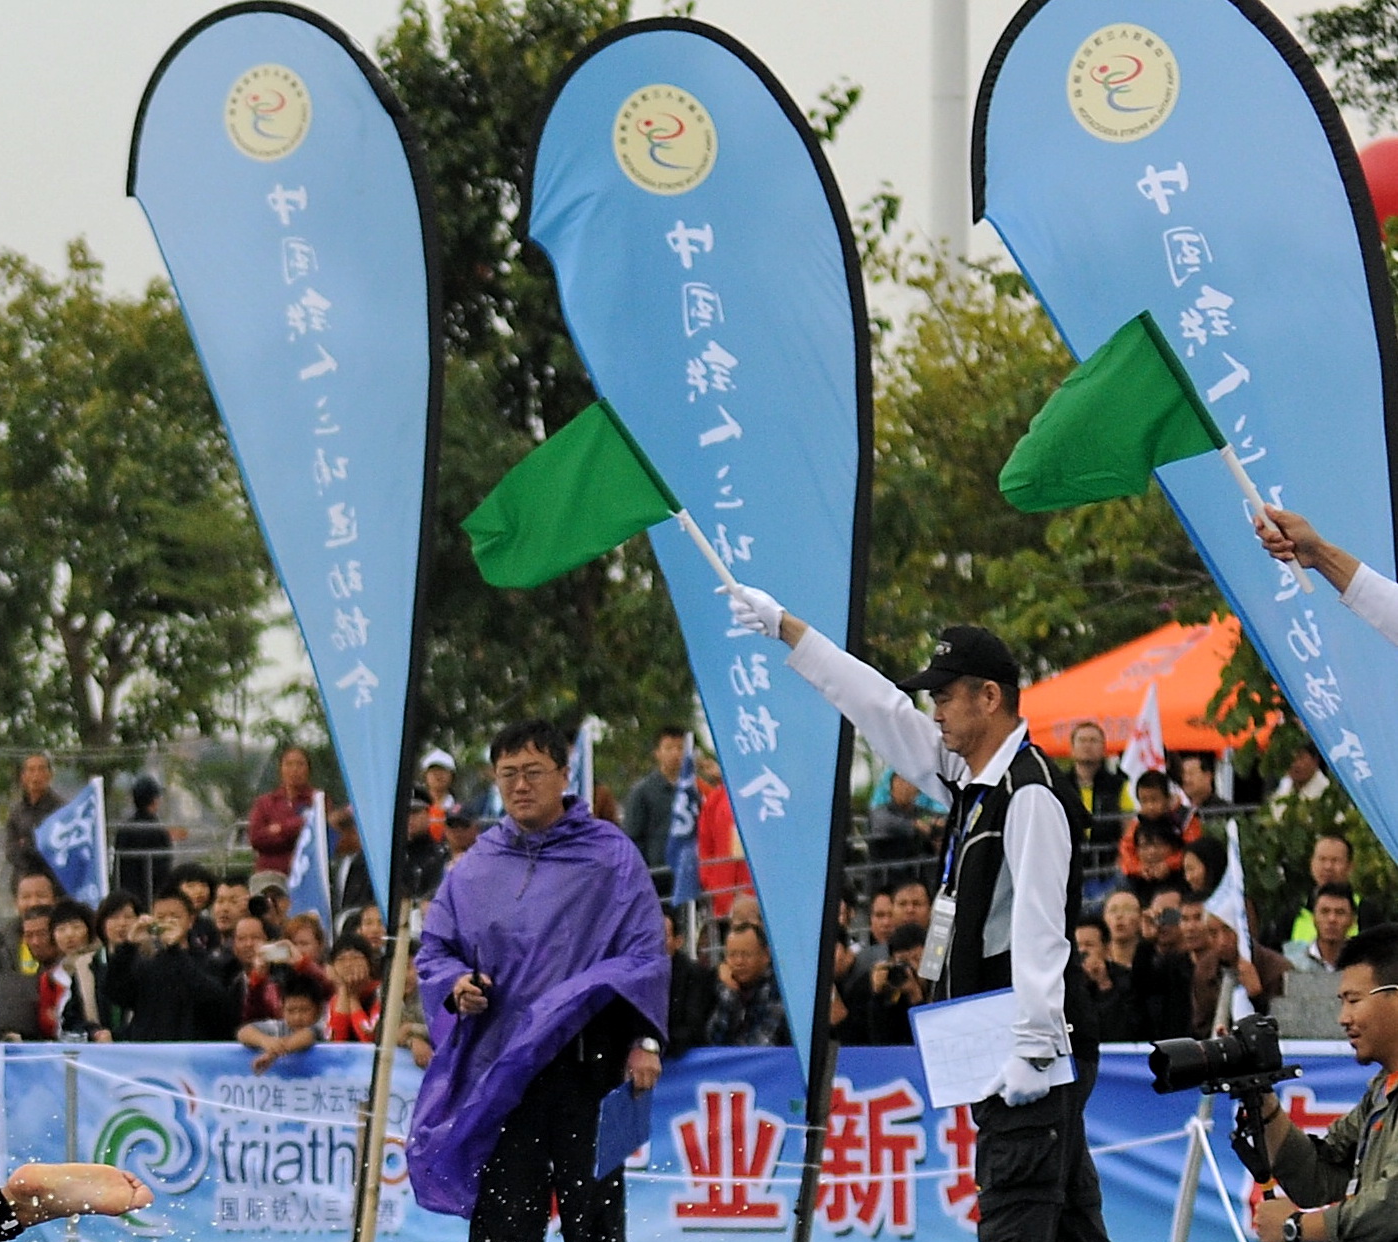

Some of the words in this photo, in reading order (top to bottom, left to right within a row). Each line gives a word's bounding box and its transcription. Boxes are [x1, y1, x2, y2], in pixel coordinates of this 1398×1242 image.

[221, 1197, 396, 1223] 国际铁人三赛
